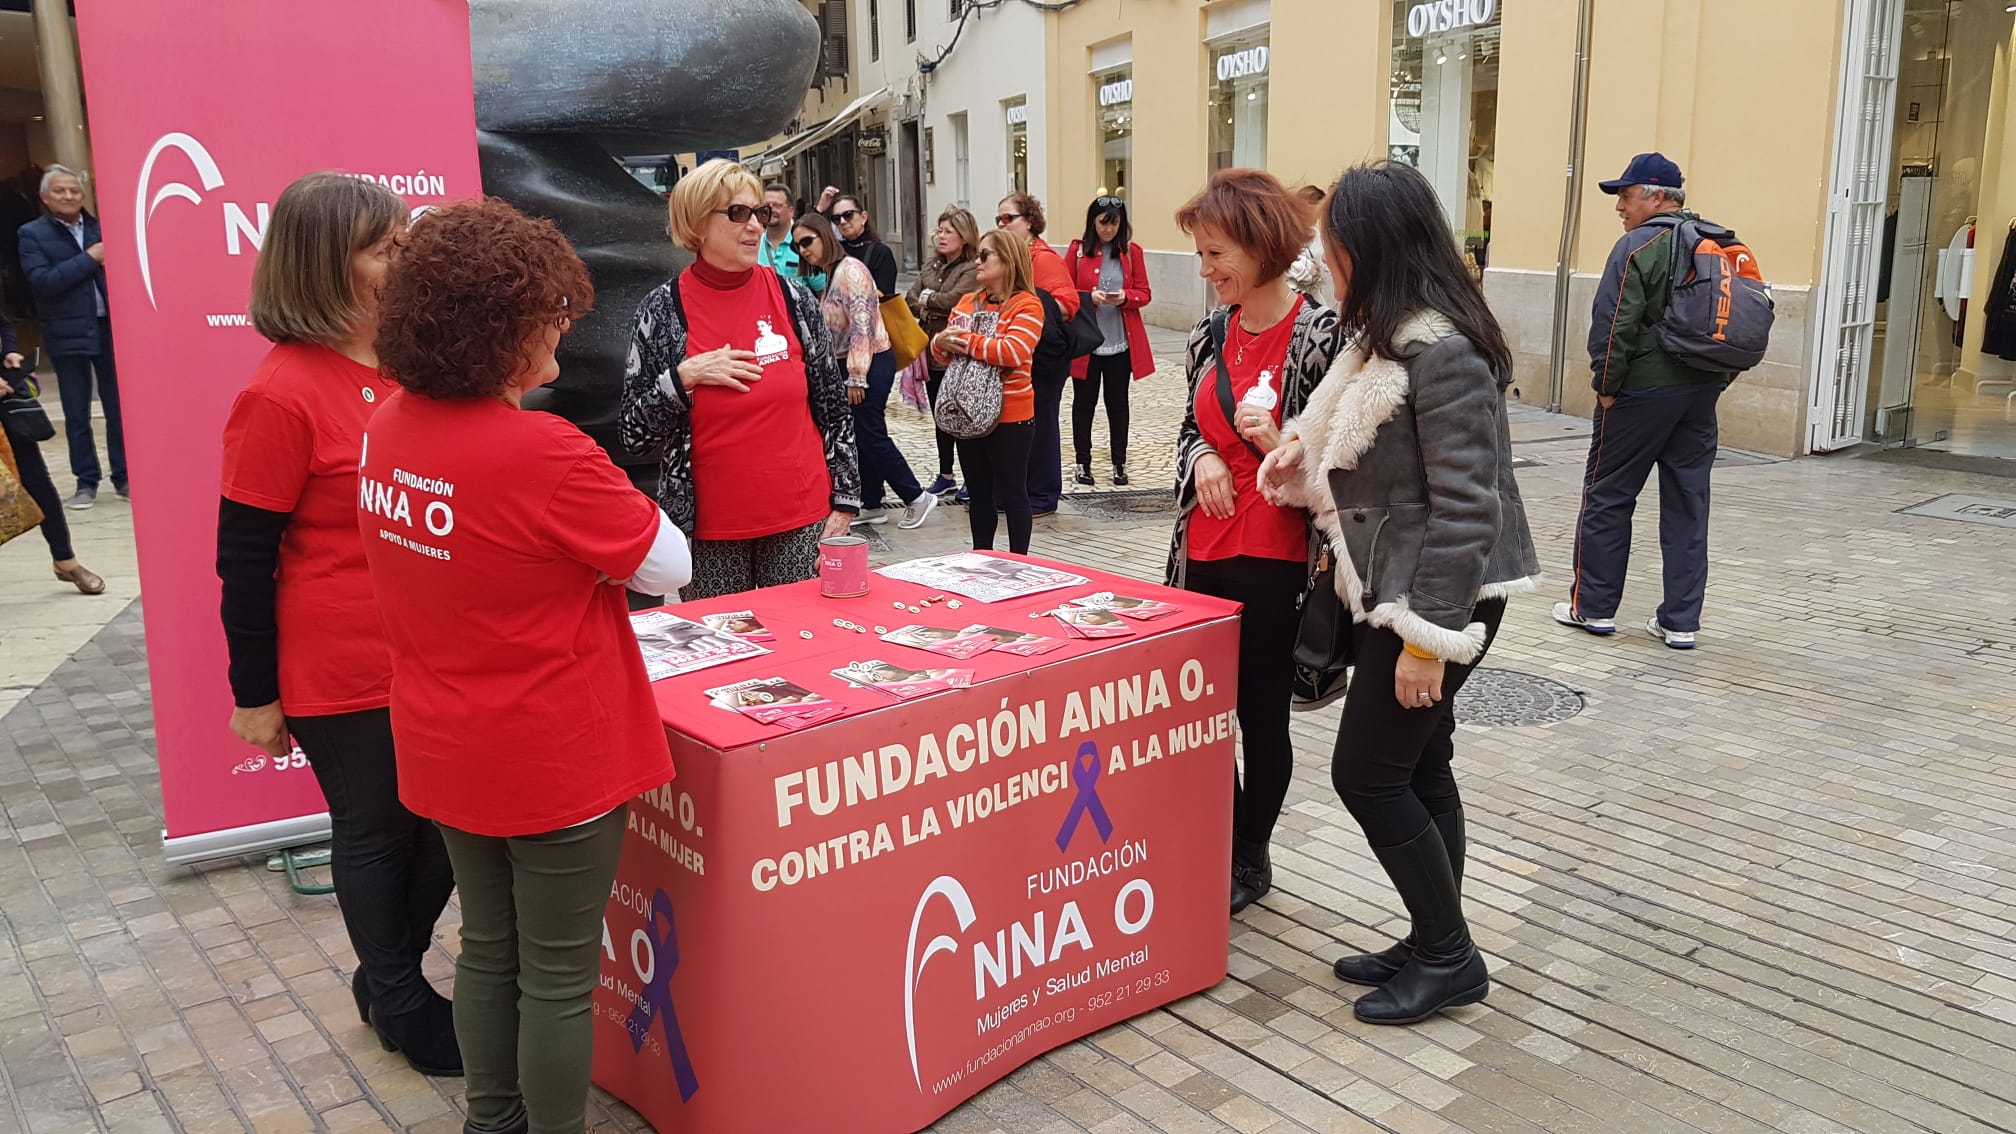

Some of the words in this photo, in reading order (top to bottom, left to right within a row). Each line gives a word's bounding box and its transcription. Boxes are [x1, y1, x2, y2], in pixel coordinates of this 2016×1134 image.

[1407, 0, 1496, 38] OYSHO
[1216, 46, 1270, 81] OYSHO
[1100, 79, 1132, 106] OYSHO
[1712, 256, 1733, 342] HEAD
[393, 467, 454, 497] FUNDACIÓN
[380, 528, 402, 546] APOYO
[403, 538, 409, 549] A
[408, 539, 451, 561] MUJERES
[425, 501, 454, 537] O
[774, 696, 1046, 828] FUNDACIÓN
[1059, 668, 1171, 739] ANNA
[1179, 658, 1214, 702] O.
[751, 822, 895, 892] CONTRA
[901, 806, 942, 846] LA
[1108, 745, 1127, 775] A
[1132, 734, 1163, 767] LA
[1168, 708, 1237, 756] MUJER
[628, 810, 639, 833] A
[641, 816, 657, 845] LA
[660, 828, 704, 876] MUJER
[1027, 838, 1148, 899] FUNDACIÓN
[1114, 878, 1154, 935] O
[631, 928, 655, 985] O
[617, 981, 651, 1017] Mental
[977, 993, 1028, 1036] Mujeres
[1032, 988, 1040, 1006] y
[1046, 966, 1090, 996] Salud
[1096, 945, 1149, 979] Mental
[932, 1006, 1075, 1095] www.fundacionannao.org
[1087, 991, 1112, 1011] 952
[1116, 985, 1130, 1001] 21
[1135, 976, 1151, 994] 29
[1154, 969, 1170, 986] 33
